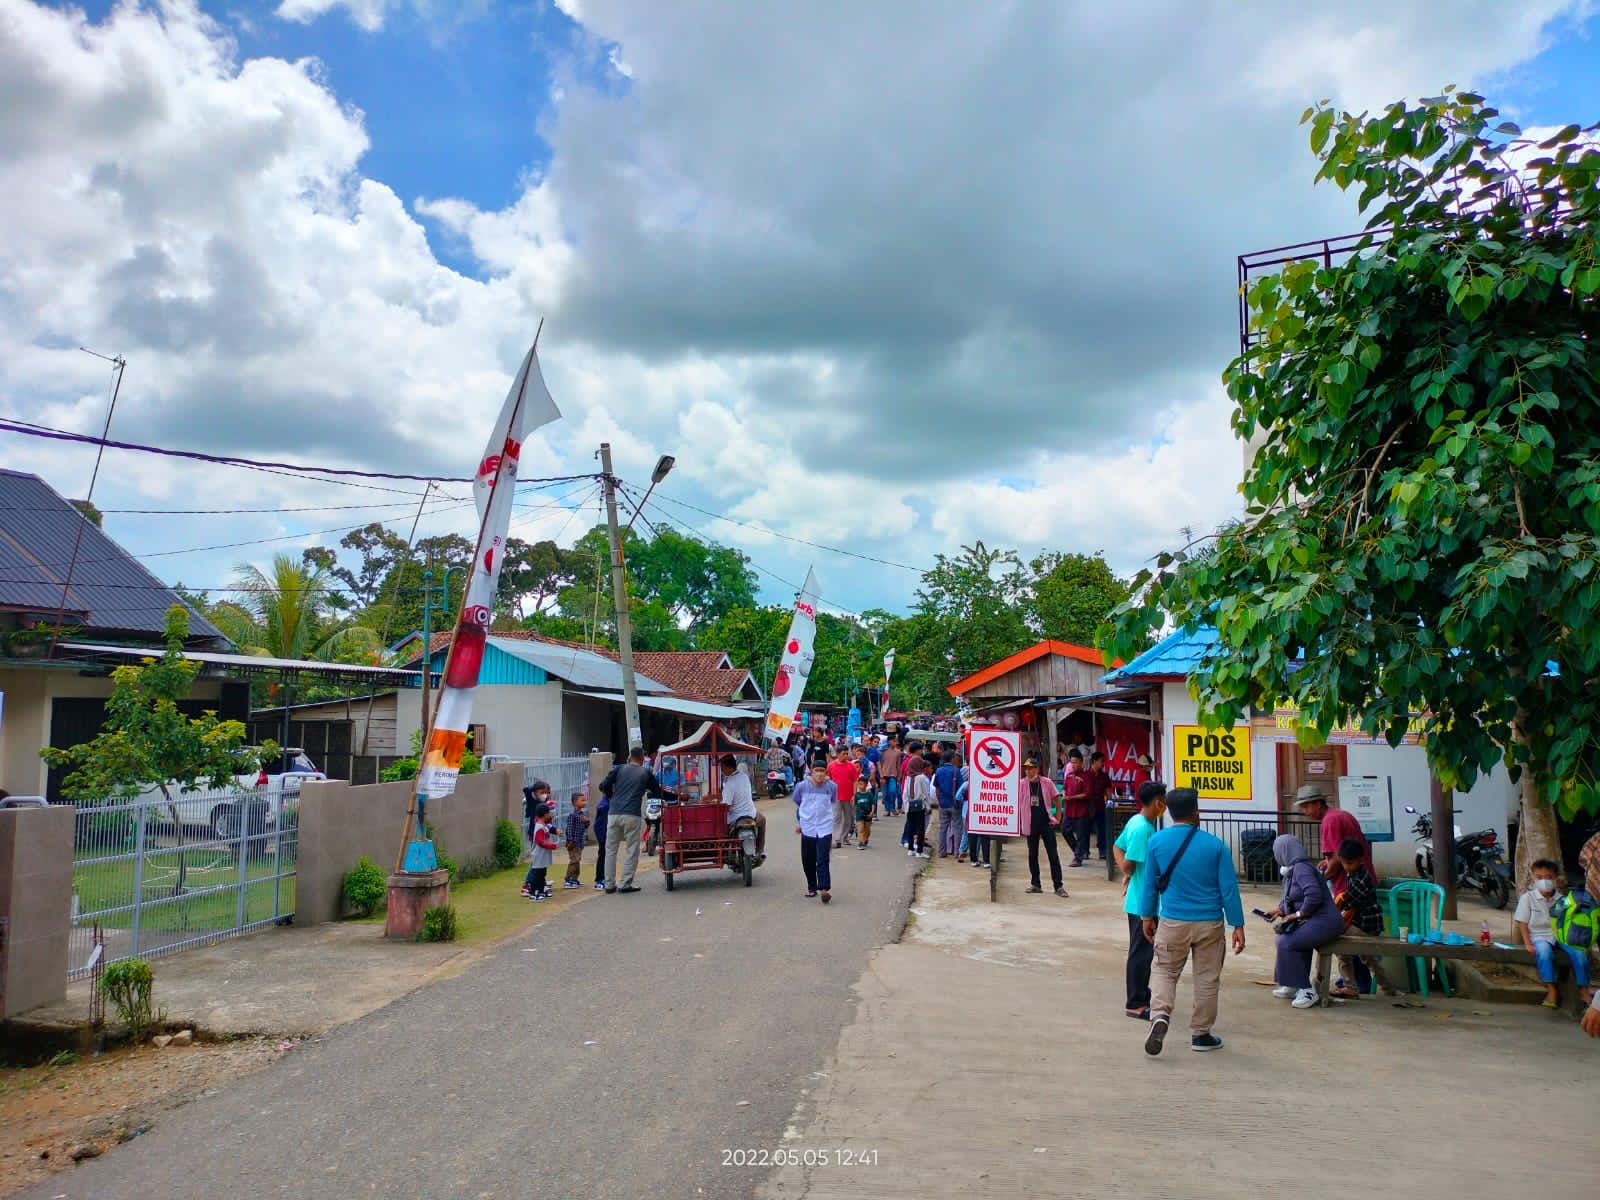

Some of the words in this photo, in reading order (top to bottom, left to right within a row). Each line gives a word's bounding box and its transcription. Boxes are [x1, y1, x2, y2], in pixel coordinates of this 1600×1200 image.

[1187, 734, 1236, 757] POS
[1181, 760, 1244, 774] RETRIBUSI
[981, 780, 1007, 791] MOBIL
[1191, 776, 1235, 791] MASUK
[979, 792, 1008, 802] MOTOR
[973, 803, 1014, 815] DILARANG
[978, 815, 1008, 826] MASUK
